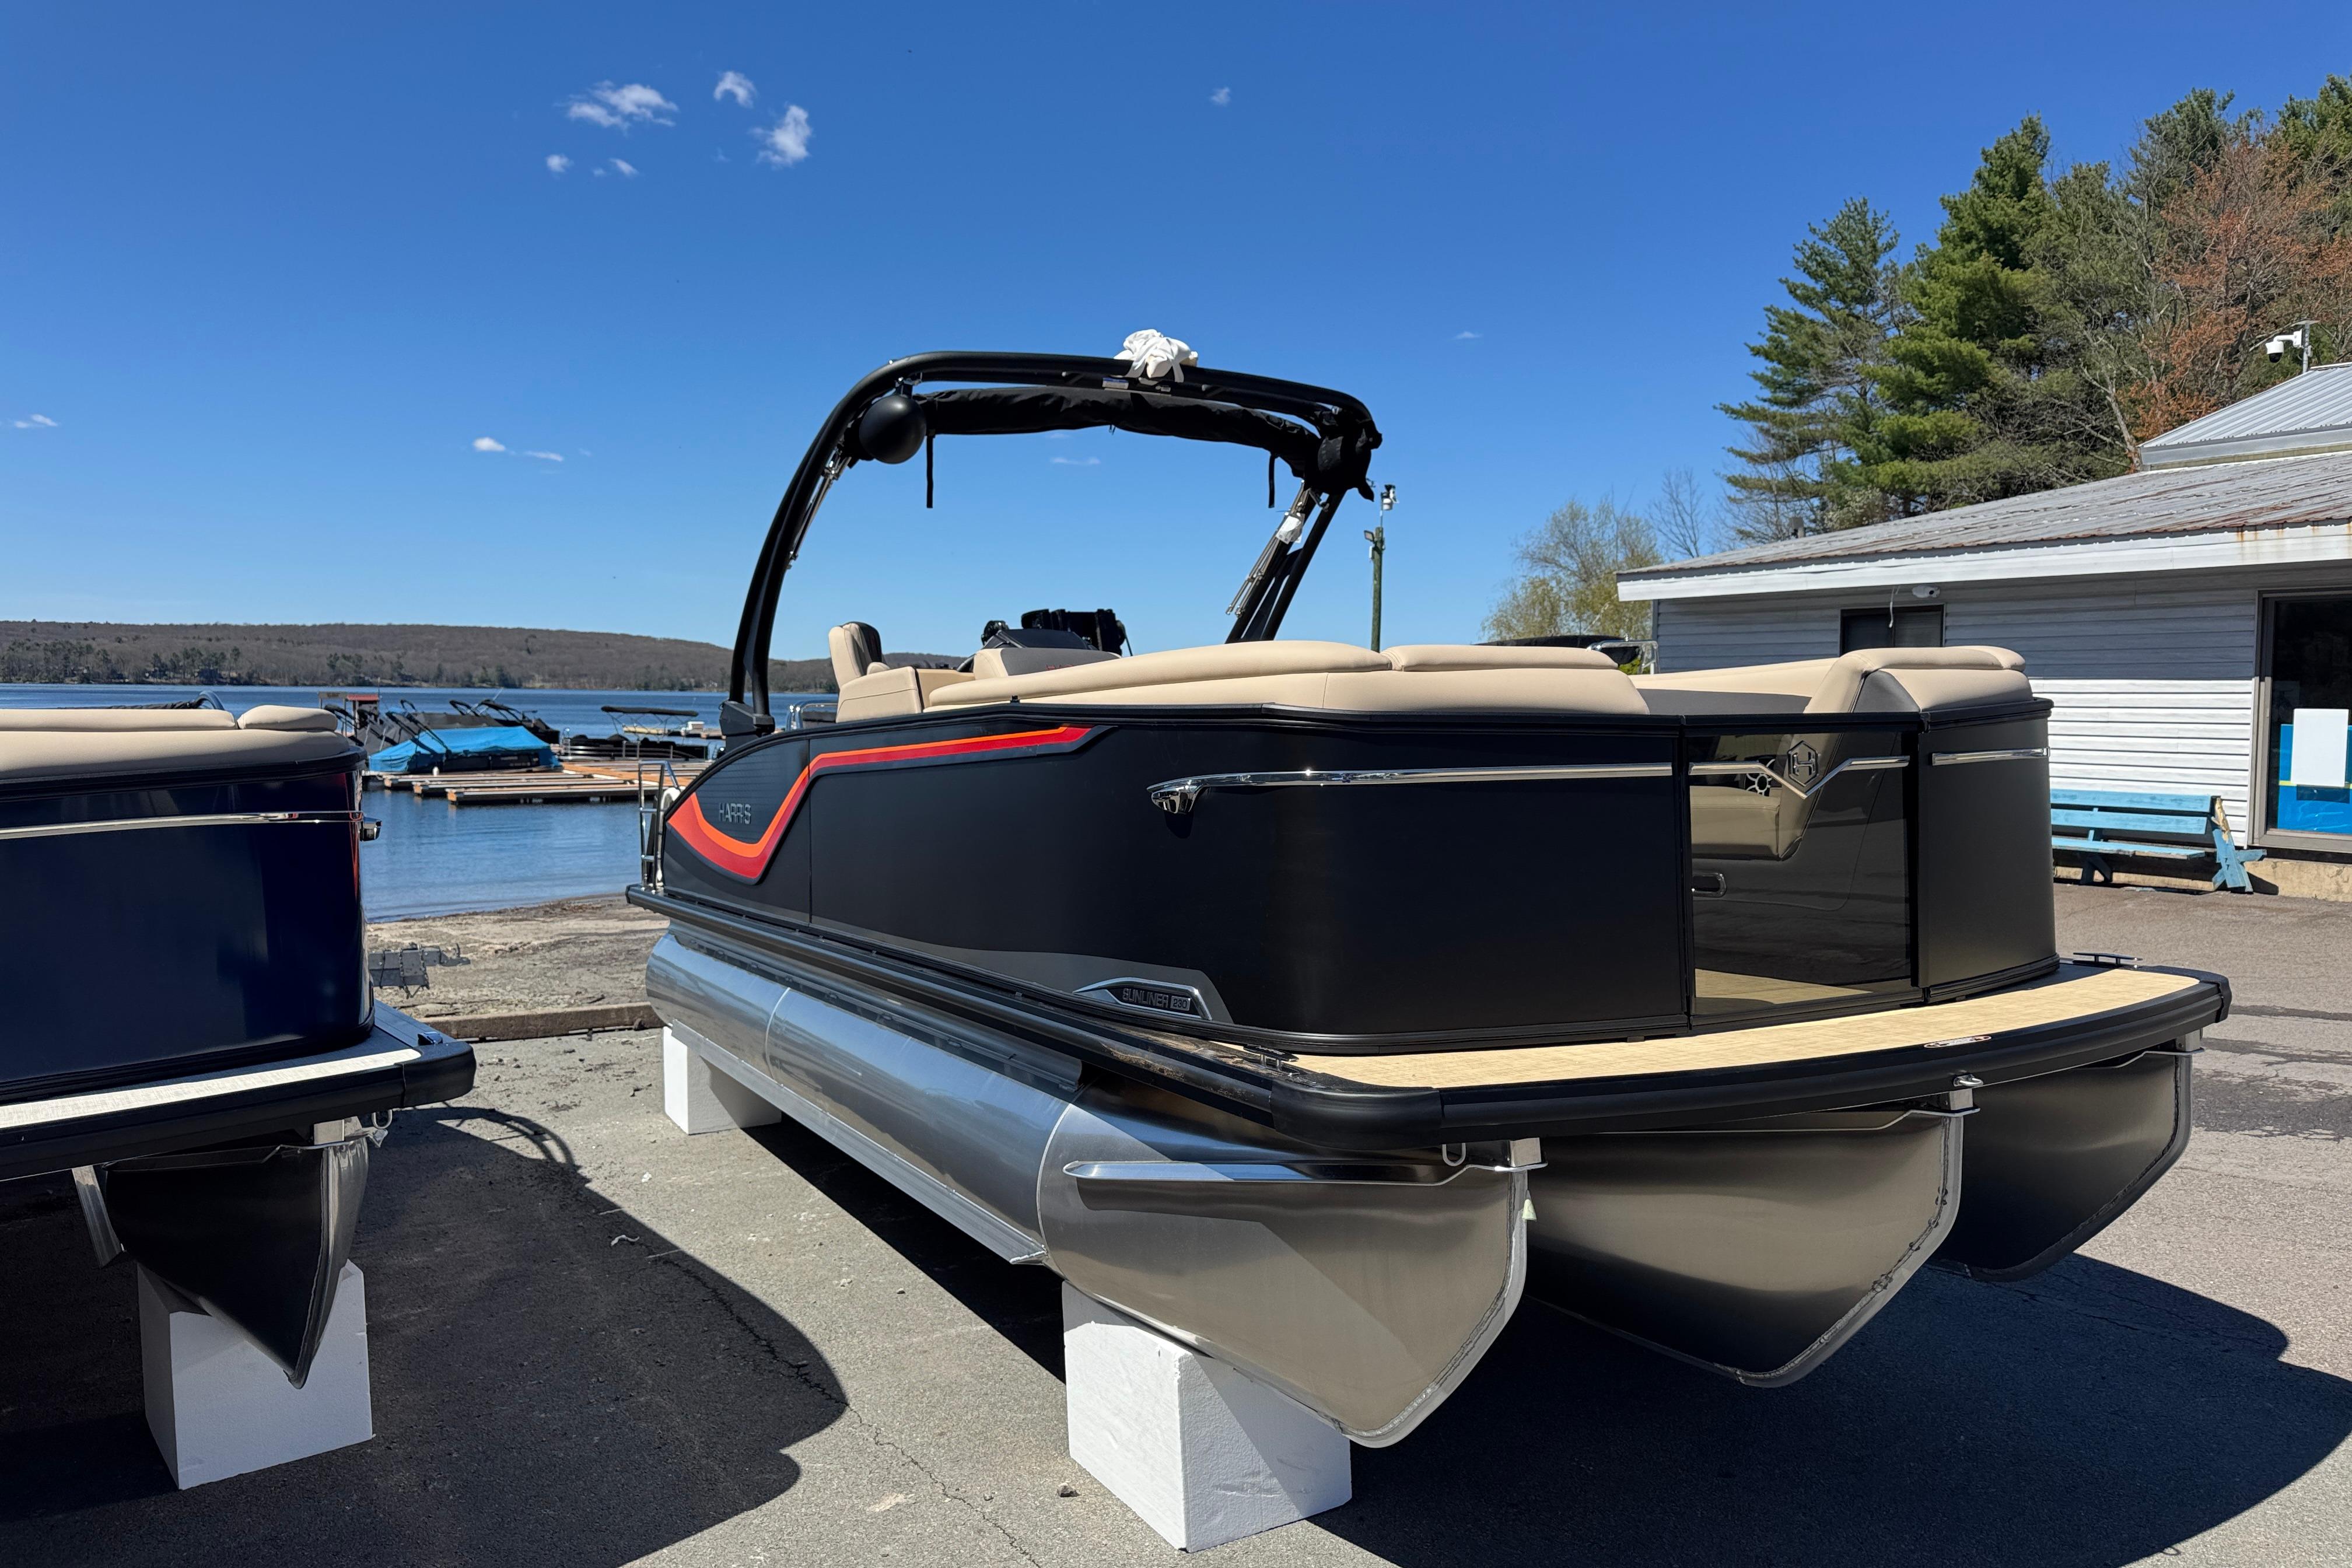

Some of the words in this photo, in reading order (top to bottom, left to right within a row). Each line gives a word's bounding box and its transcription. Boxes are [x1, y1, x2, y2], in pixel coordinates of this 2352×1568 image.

[719, 802, 751, 824] HARRIS
[1122, 988, 1168, 1008] SUNLINER
[1172, 998, 1188, 1009] 230
